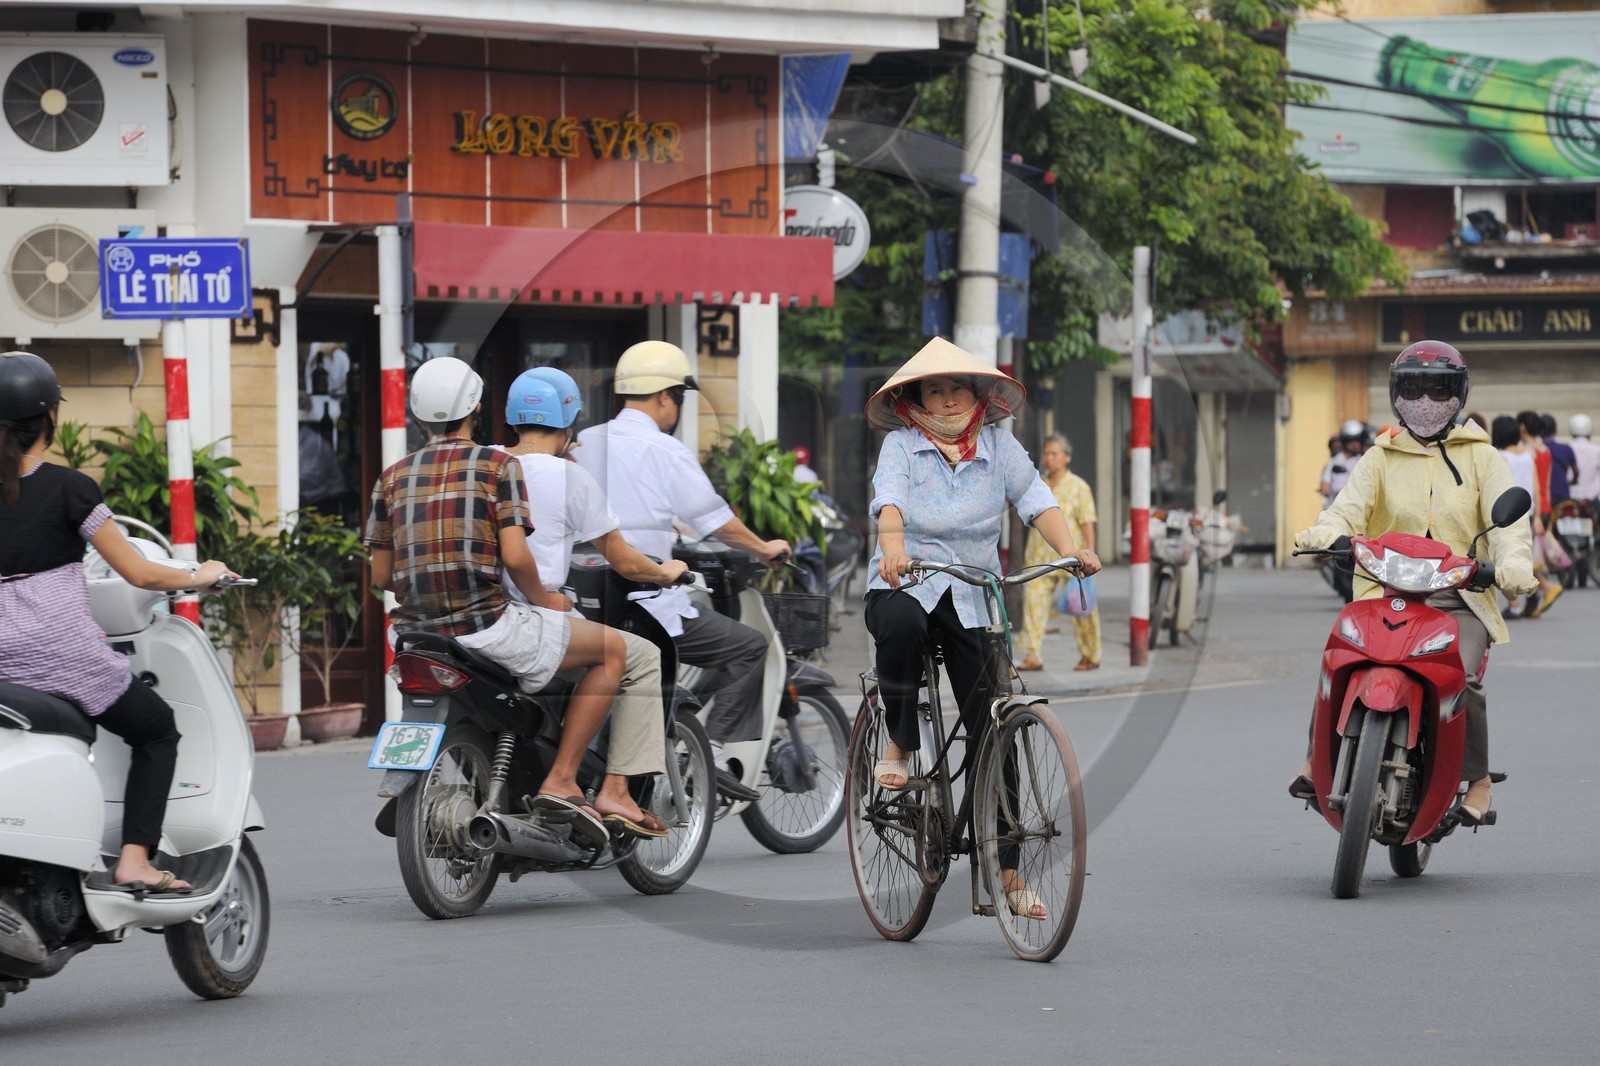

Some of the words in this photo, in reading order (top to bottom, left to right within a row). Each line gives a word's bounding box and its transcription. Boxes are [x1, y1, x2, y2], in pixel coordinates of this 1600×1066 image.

[452, 109, 580, 158] LONG
[118, 269, 147, 304] LÊ
[152, 268, 199, 304] THÁI
[1543, 308, 1592, 333] ANH
